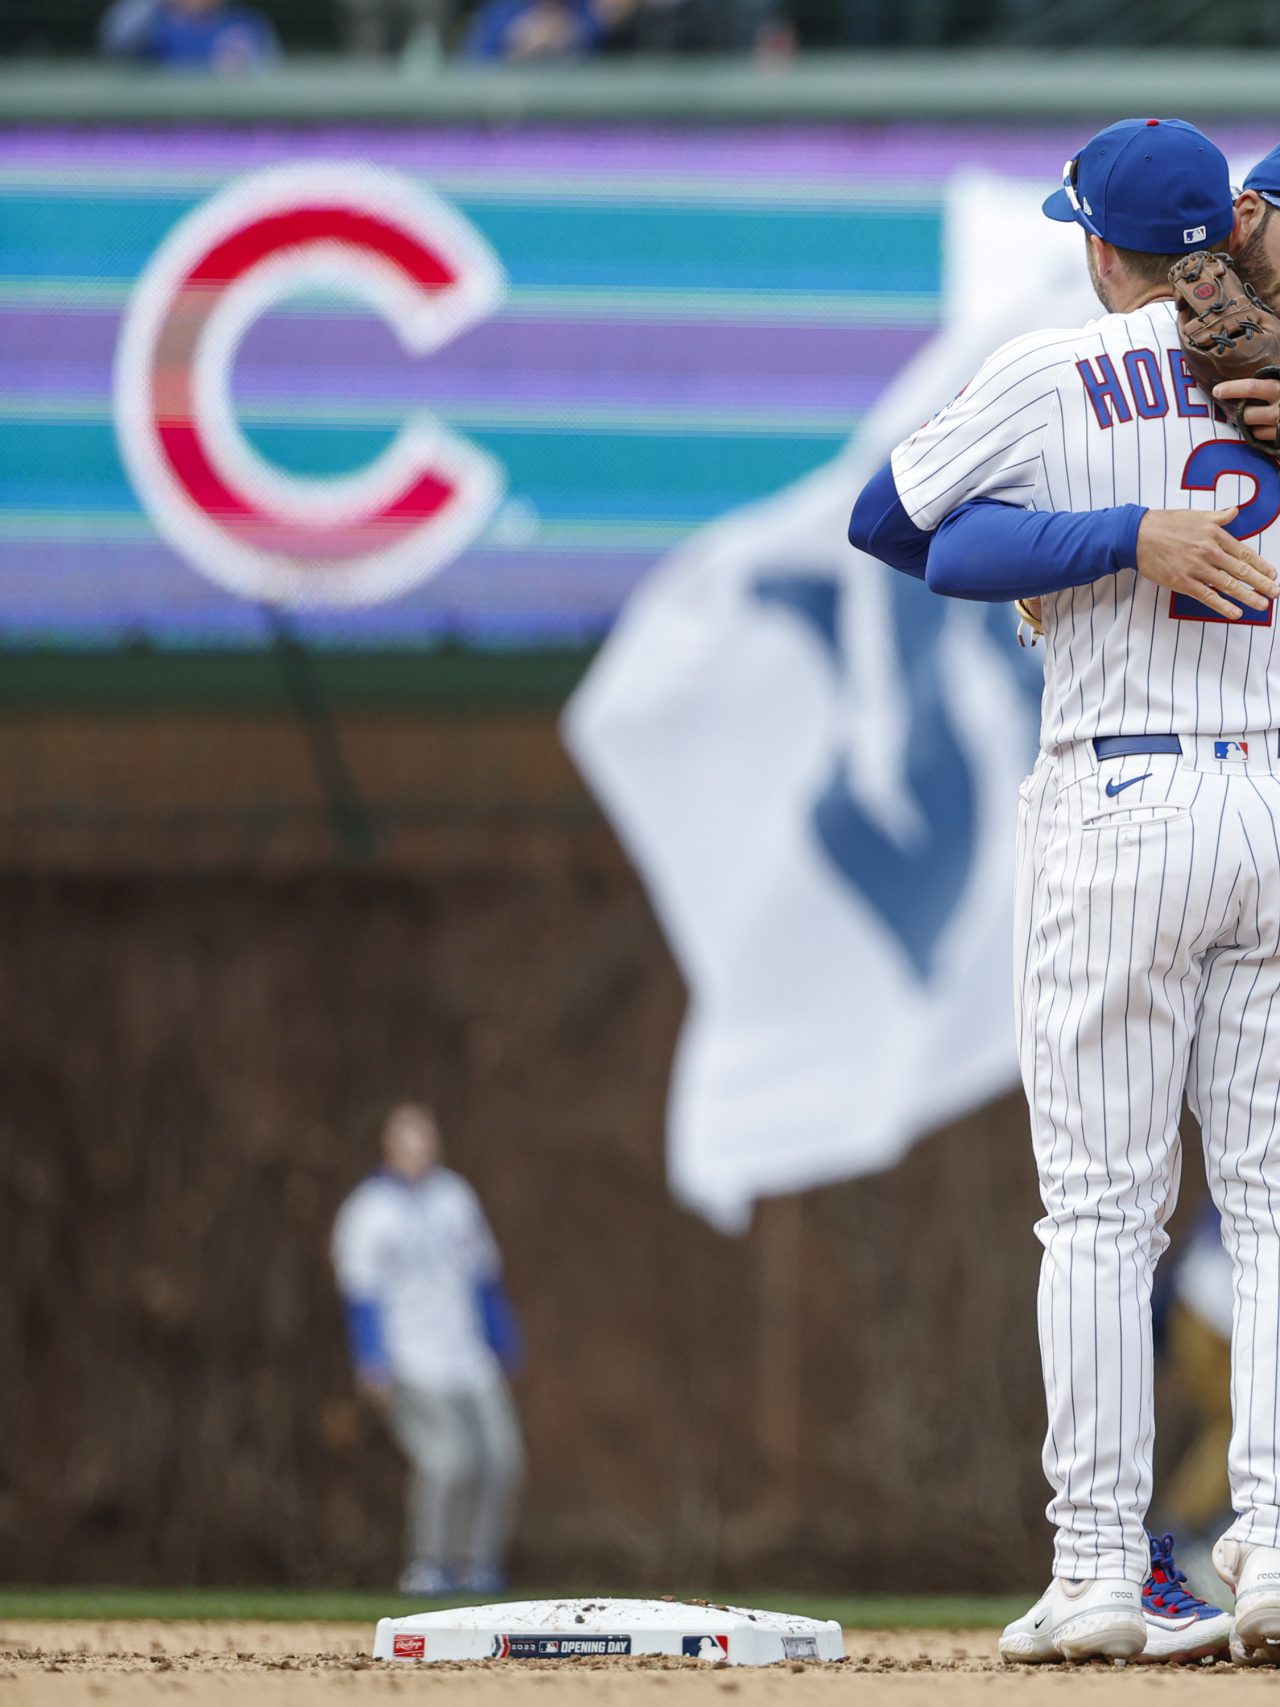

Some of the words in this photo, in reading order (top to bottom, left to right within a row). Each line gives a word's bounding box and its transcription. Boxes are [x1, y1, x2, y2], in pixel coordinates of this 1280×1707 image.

[114, 162, 506, 606] C
[1075, 347, 1228, 430] HOE
[561, 1641, 605, 1653] OPENING
[607, 1641, 628, 1653] DAY
